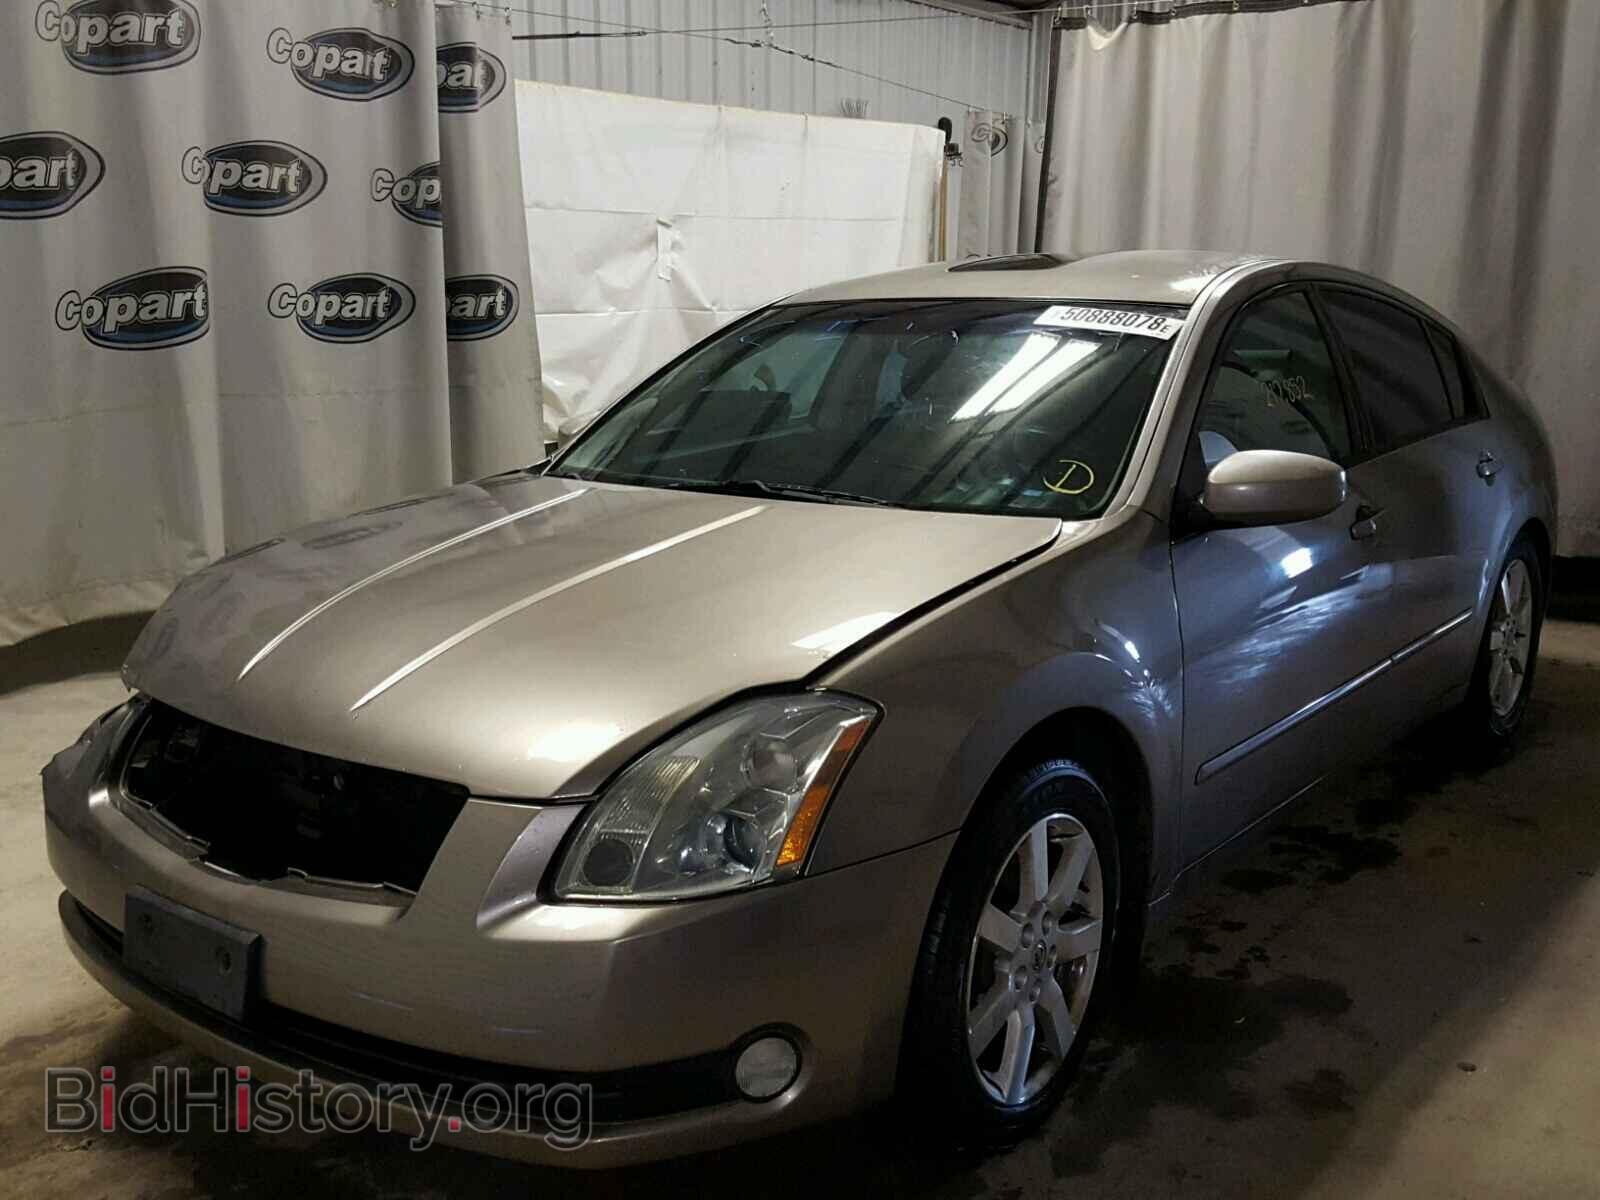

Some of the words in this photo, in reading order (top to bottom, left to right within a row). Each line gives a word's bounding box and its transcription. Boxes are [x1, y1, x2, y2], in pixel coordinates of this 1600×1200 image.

[35, 0, 187, 56] Copart
[267, 27, 391, 82] Copart
[182, 147, 301, 194] Copart
[371, 168, 441, 210] Cop
[55, 283, 208, 335] Copart
[267, 283, 393, 326] Copart
[446, 287, 506, 320] art
